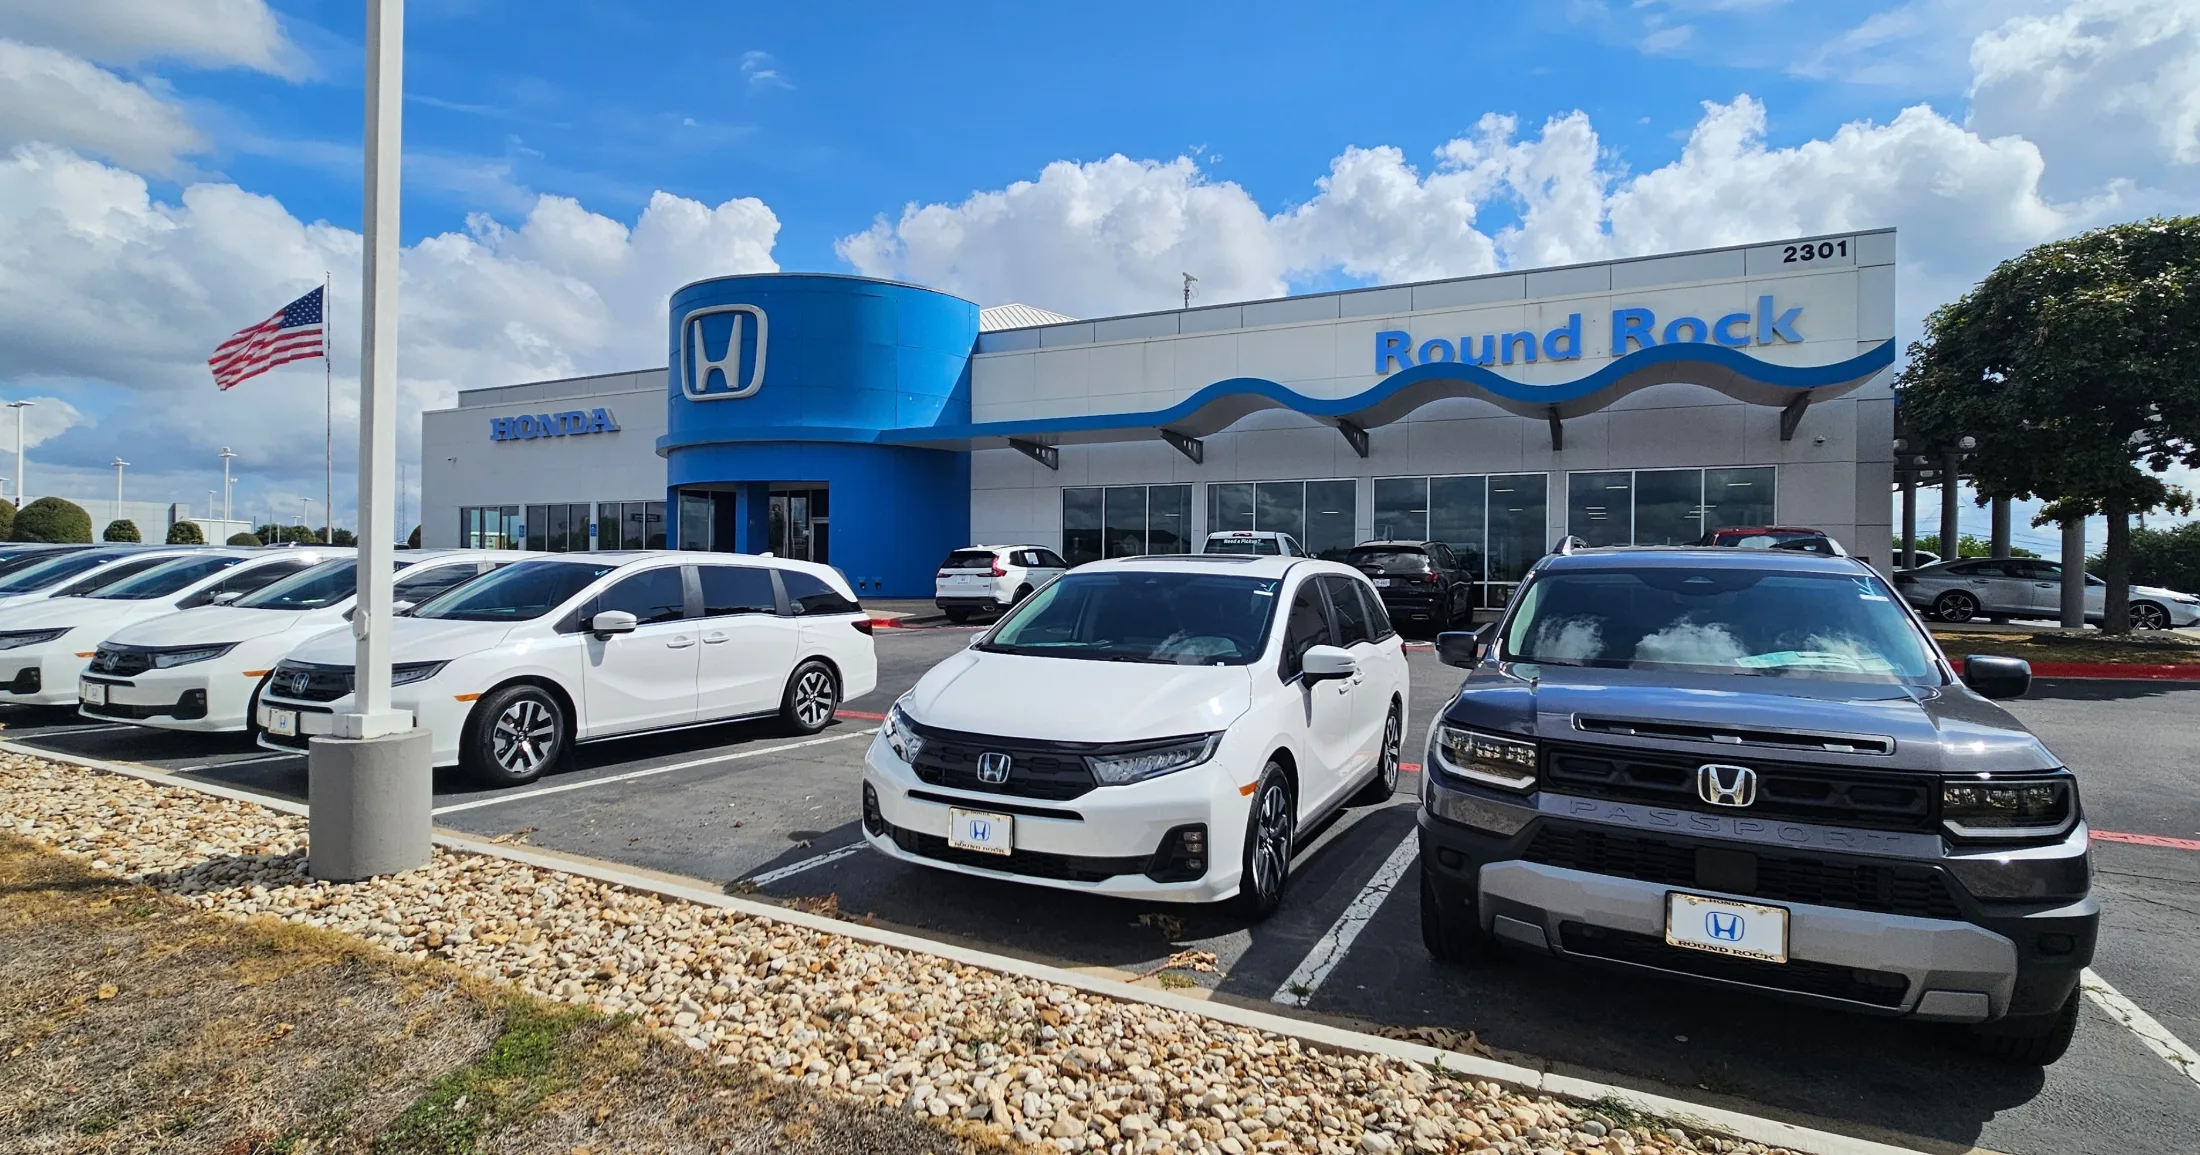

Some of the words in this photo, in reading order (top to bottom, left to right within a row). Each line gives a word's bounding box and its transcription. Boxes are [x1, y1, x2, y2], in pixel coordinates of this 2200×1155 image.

[1783, 240, 1847, 263] 2301
[1375, 313, 1582, 374] Round
[1611, 295, 1806, 357] Rock
[489, 408, 621, 441] HONDA
[1570, 800, 1900, 851] PASSPORT
[1708, 898, 1747, 908] HONDA
[1677, 940, 1729, 953] ROUND
[1732, 948, 1777, 961] ROCK
